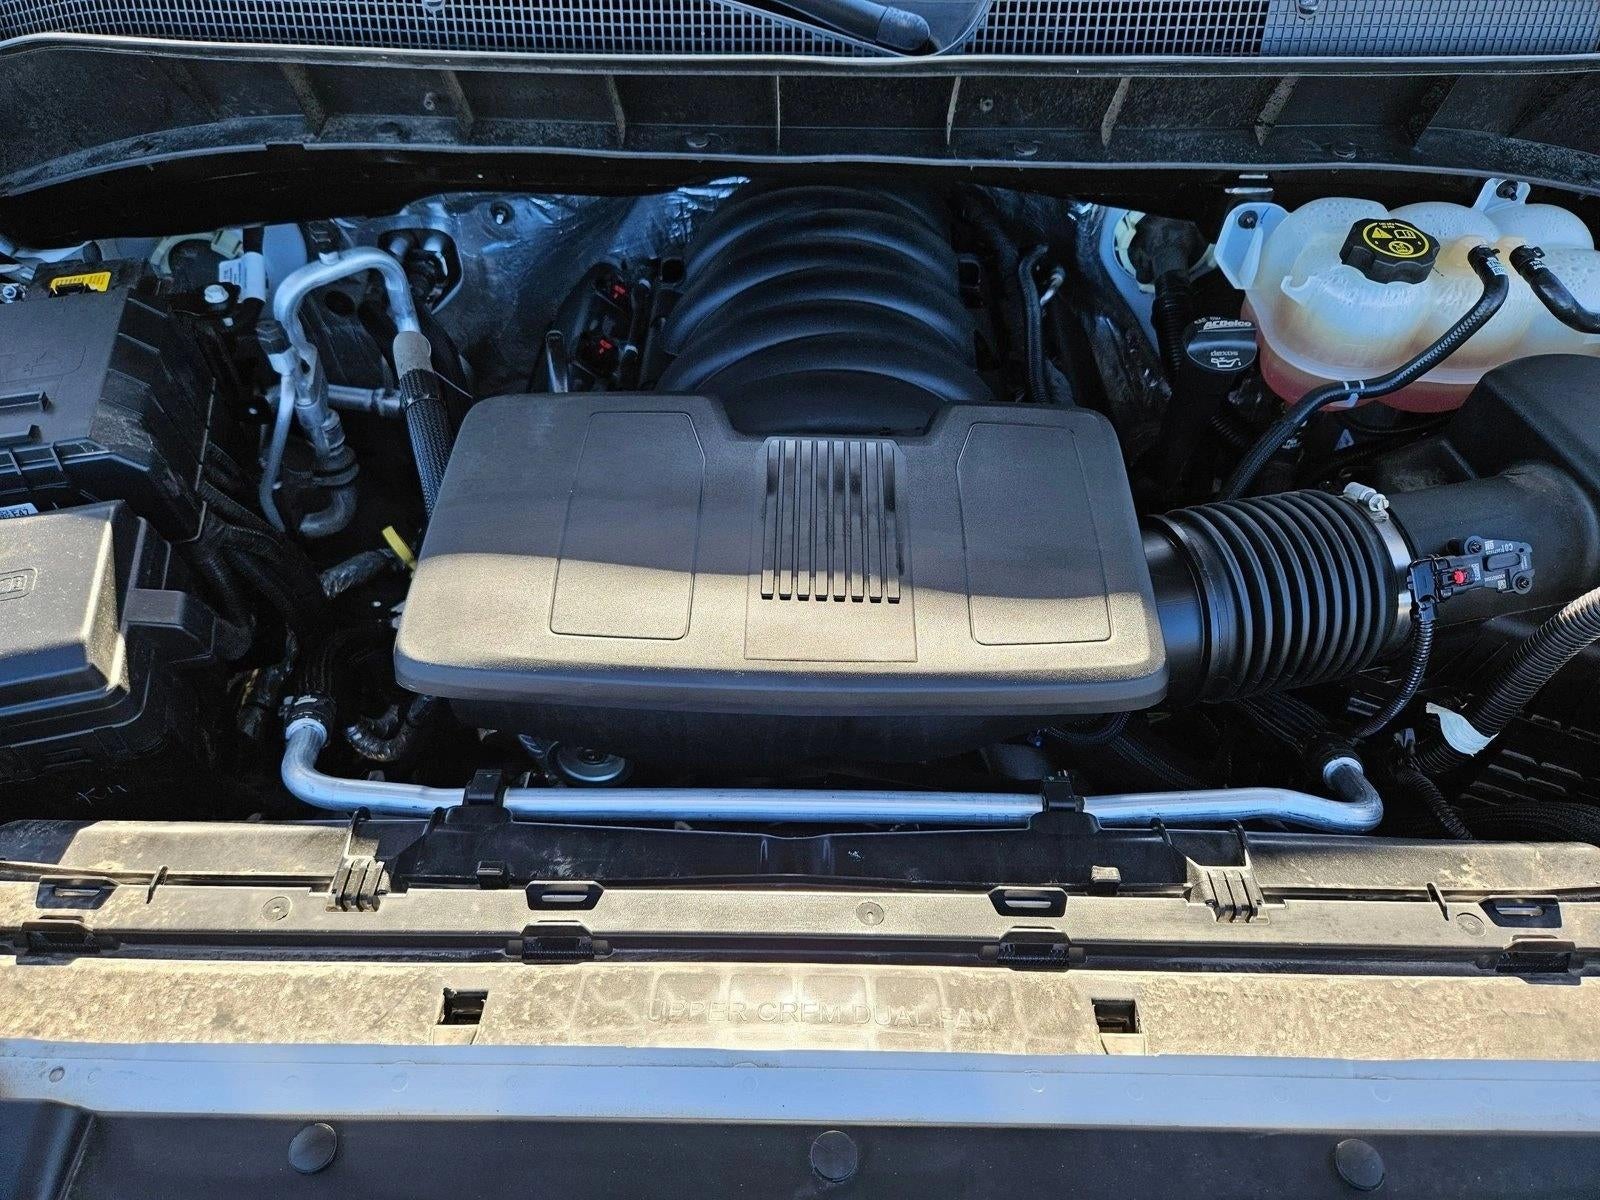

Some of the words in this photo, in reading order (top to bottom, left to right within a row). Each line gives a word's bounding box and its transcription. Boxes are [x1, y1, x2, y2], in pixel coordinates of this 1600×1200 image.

[1203, 320, 1252, 330] ACDelco
[648, 1001, 748, 1022] UPPER
[757, 1001, 841, 1024] CRFM
[853, 1004, 931, 1028] DUAL
